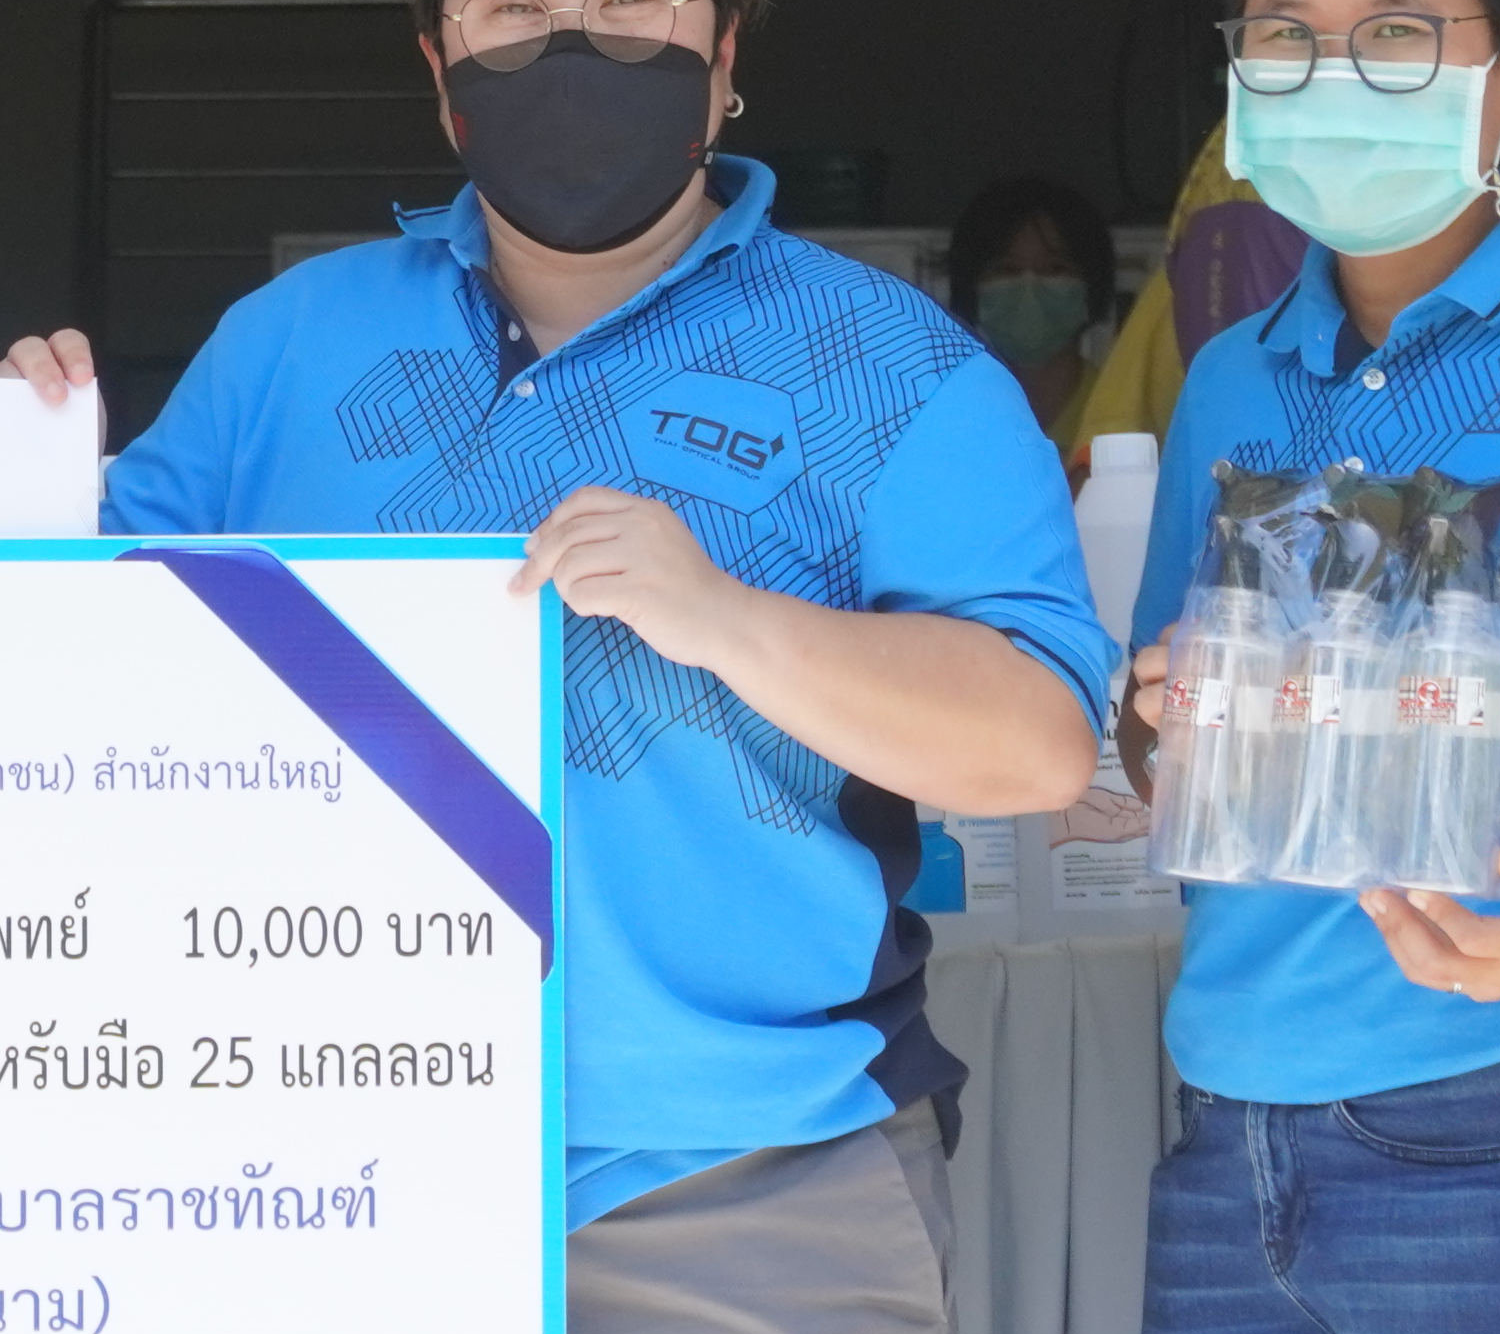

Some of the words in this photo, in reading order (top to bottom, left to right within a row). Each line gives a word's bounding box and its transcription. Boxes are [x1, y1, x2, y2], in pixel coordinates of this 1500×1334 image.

[650, 409, 768, 470] TOG
[653, 437, 677, 447] THAI
[682, 446, 722, 465] OPTICAL
[726, 463, 761, 481] GROUP
[93, 744, 344, 804] สำนักงานใหญ่
[183, 905, 363, 969] 10,000
[387, 908, 496, 961] บาท
[189, 1036, 255, 1089] 25
[281, 1042, 496, 1089] แกลลอน
